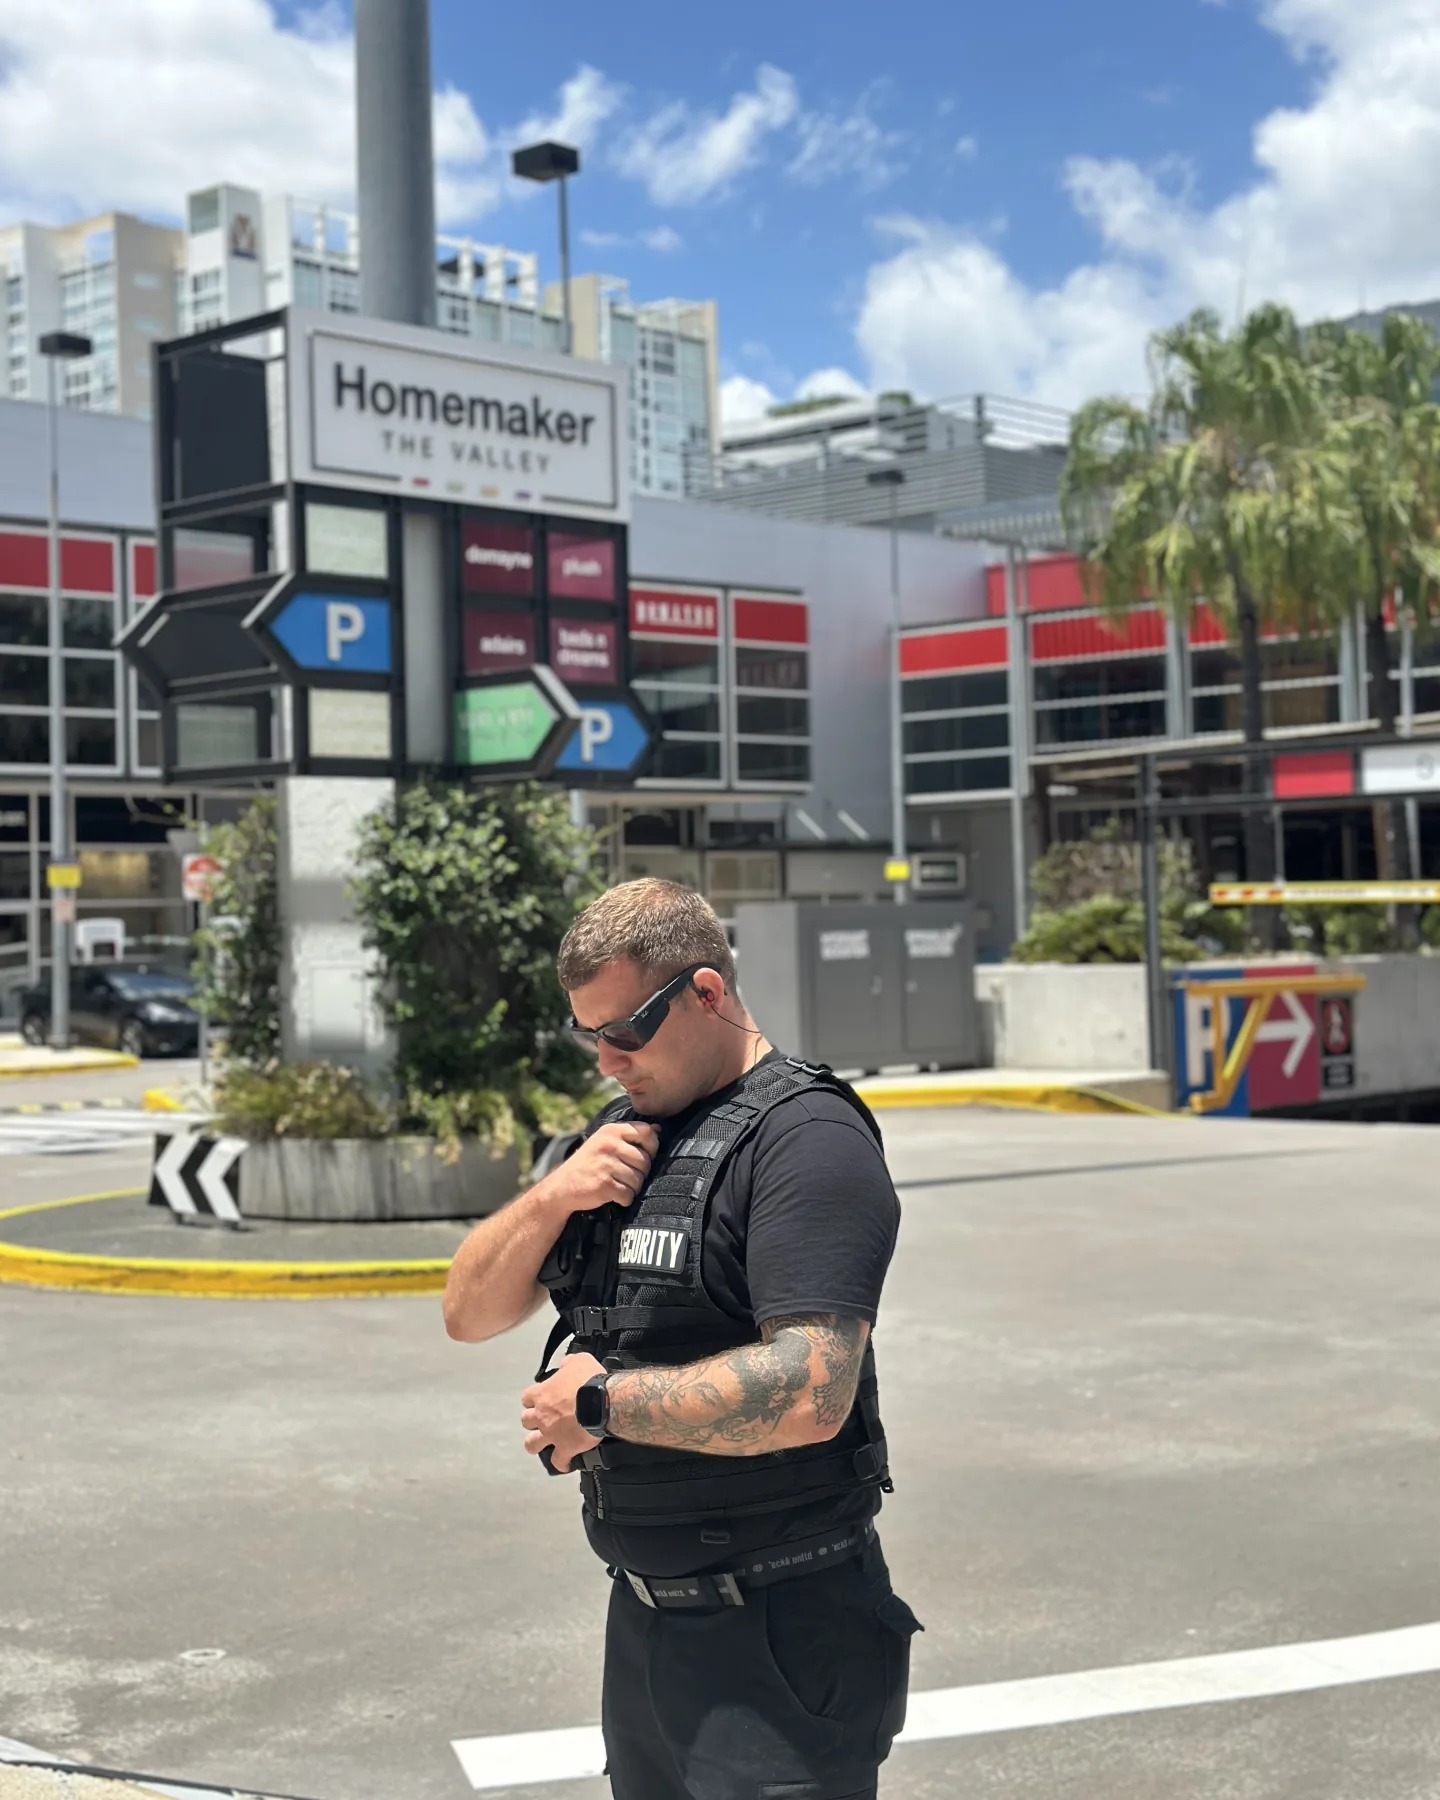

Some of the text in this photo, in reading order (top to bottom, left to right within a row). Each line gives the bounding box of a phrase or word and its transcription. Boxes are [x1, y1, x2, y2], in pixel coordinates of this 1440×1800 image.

[333, 361, 595, 446] Homemaker
[382, 430, 551, 473] THE VALLEY
[325, 602, 366, 662] P
[580, 708, 613, 763] P
[1185, 994, 1232, 1087] P
[618, 1228, 685, 1269] SECURITY
